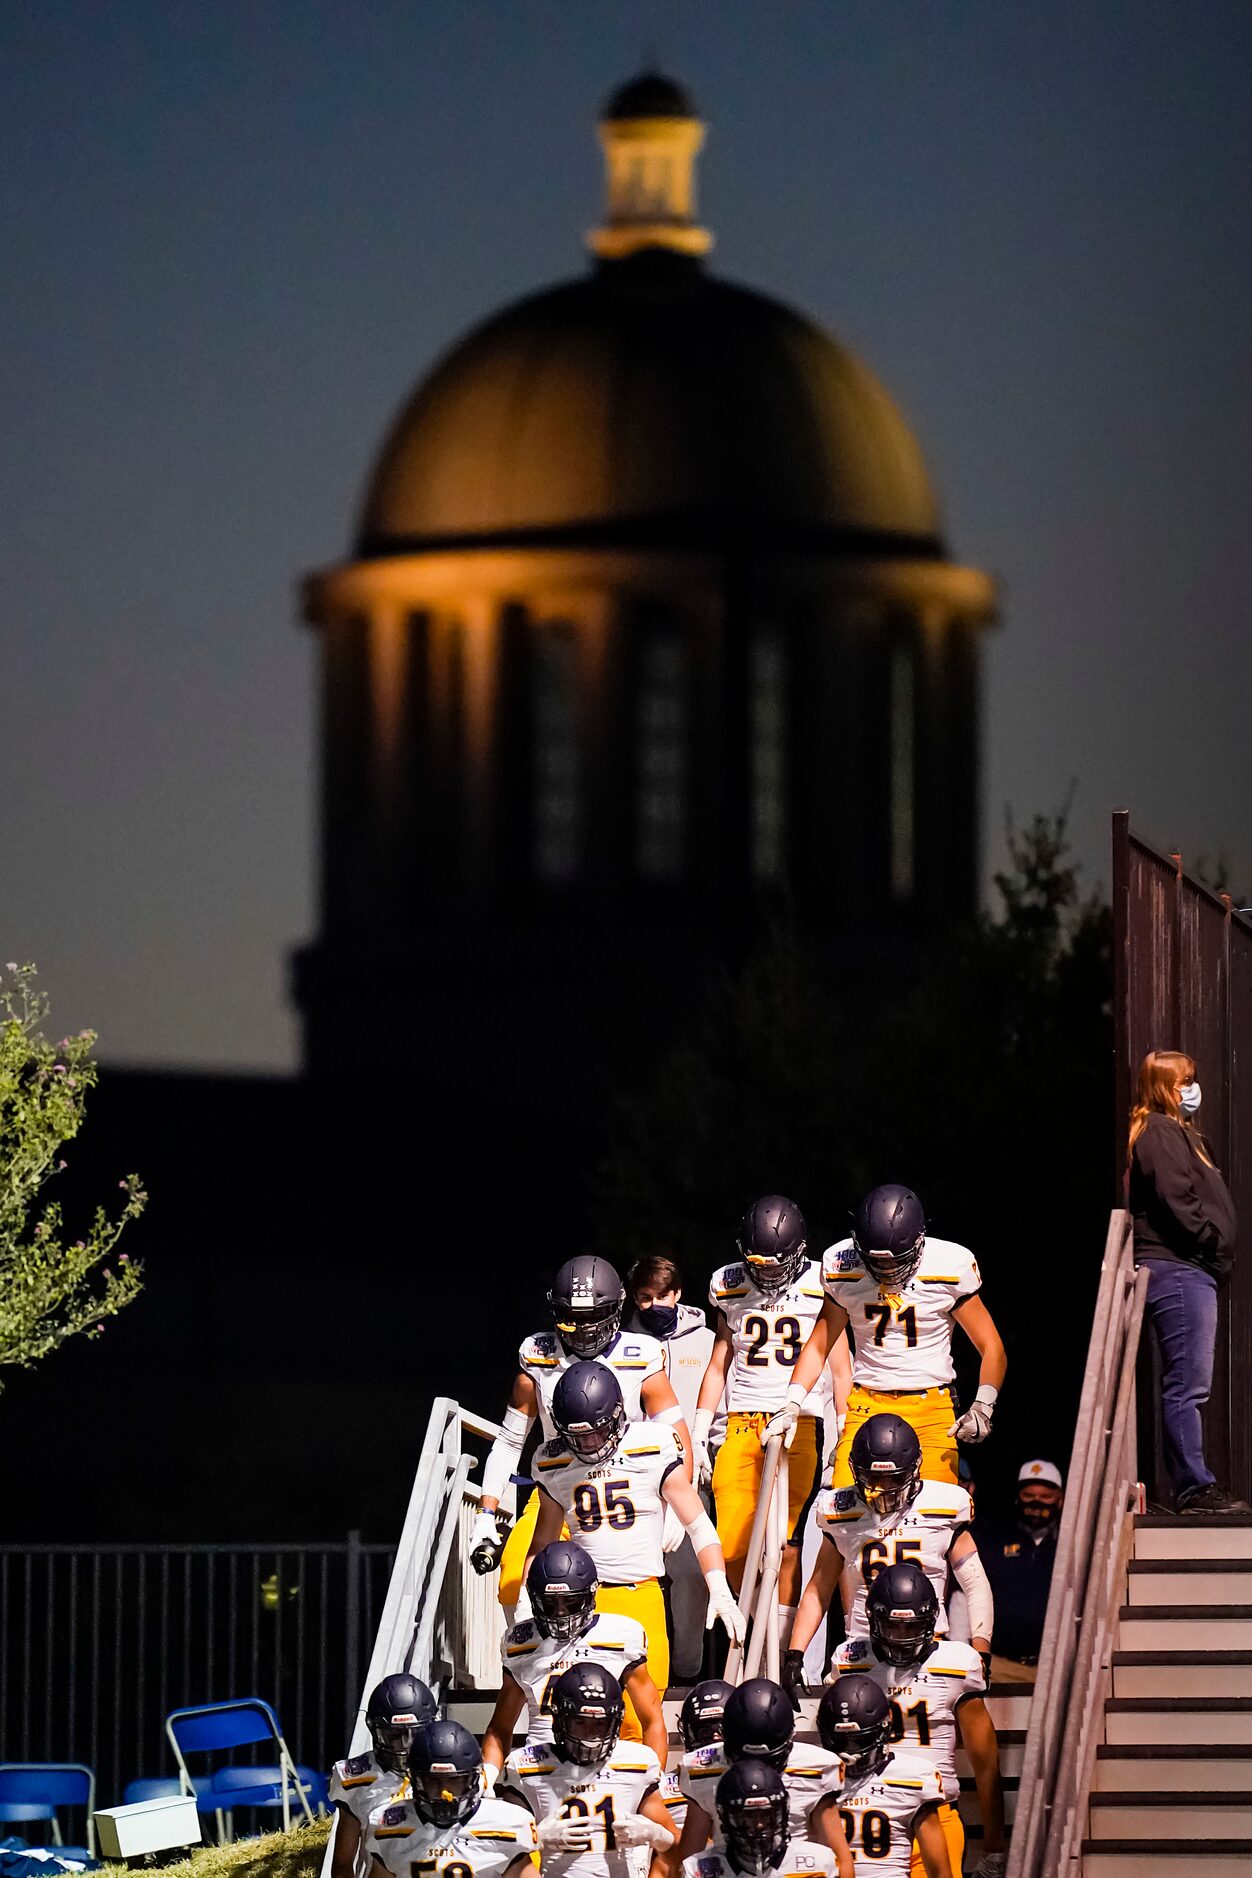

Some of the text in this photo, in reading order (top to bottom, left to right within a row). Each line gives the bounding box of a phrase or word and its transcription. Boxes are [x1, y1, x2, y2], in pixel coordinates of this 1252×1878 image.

[877, 1292, 902, 1301] SCS
[760, 1304, 785, 1312] SCOTS
[864, 1302, 919, 1348] 71
[744, 1313, 804, 1368] 23
[623, 1346, 641, 1357] C
[672, 1432, 684, 1452] 9
[587, 1469, 612, 1480] SCOTS
[573, 1479, 636, 1533] 95
[878, 1528, 903, 1537] SCOTS
[887, 1687, 912, 1696] SCOTS
[570, 1784, 597, 1794] SCOTS
[843, 1798, 870, 1806] SCOTS
[428, 1848, 455, 1857] SCOTS
[796, 1855, 815, 1868] PC
